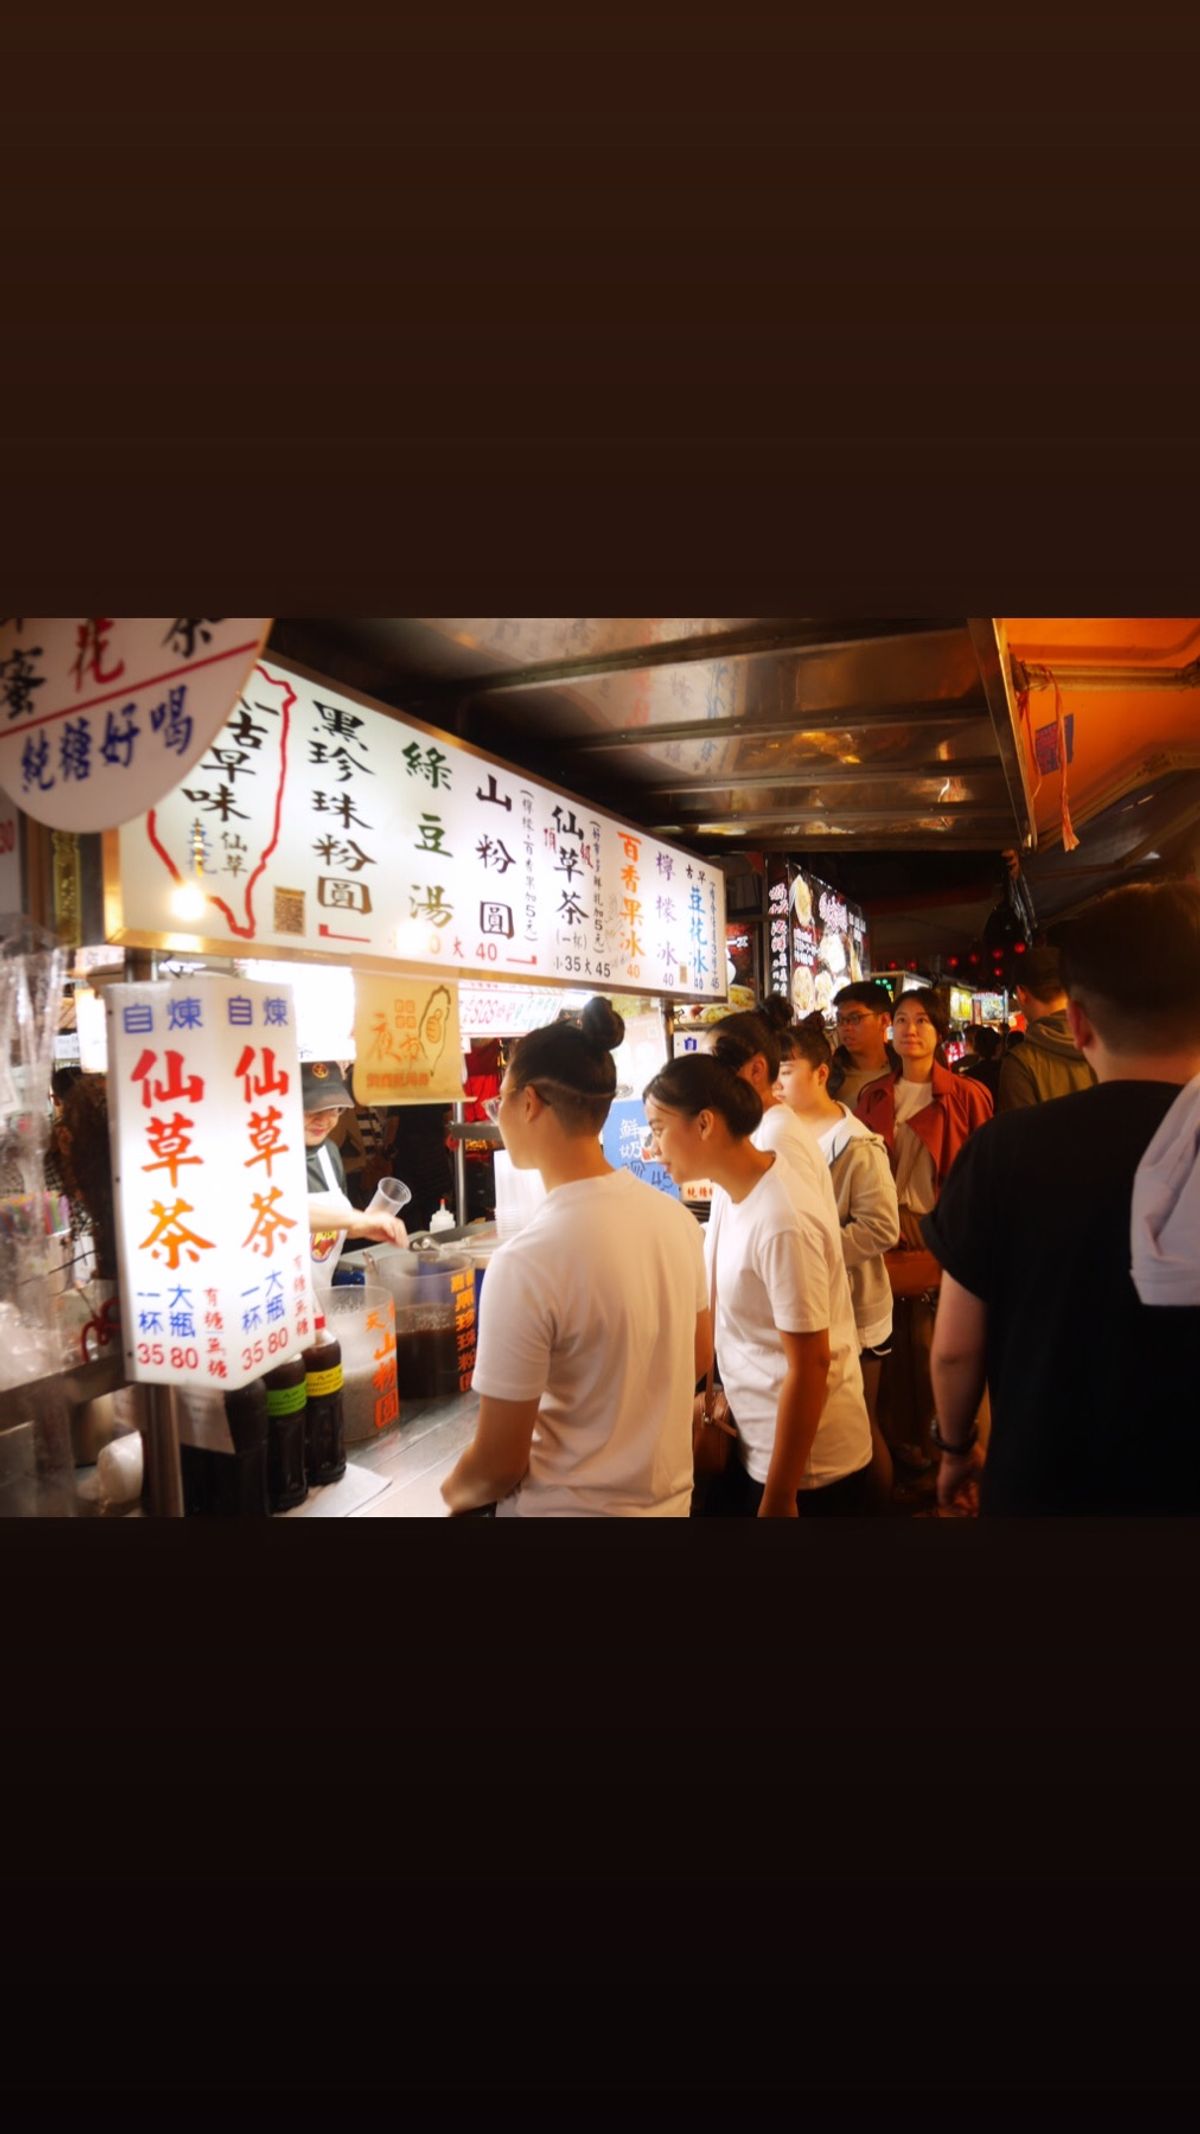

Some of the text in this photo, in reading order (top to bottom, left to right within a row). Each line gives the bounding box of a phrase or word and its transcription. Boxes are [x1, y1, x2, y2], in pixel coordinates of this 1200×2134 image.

[308, 700, 379, 914] 黑珍珠粉圓
[402, 741, 455, 929] 綠豆湯
[475, 774, 517, 940] 山粉圓
[552, 804, 590, 926] 仙草茶
[617, 831, 647, 959] 百香果冰
[626, 964, 641, 979] 40
[662, 972, 675, 987] 40
[128, 1048, 218, 1271] 仙草茶
[234, 1043, 299, 1258] 仙草茶
[136, 1342, 165, 1367] 35
[169, 1345, 200, 1370] 80
[241, 1339, 266, 1373] 35
[266, 1326, 290, 1356] 80
